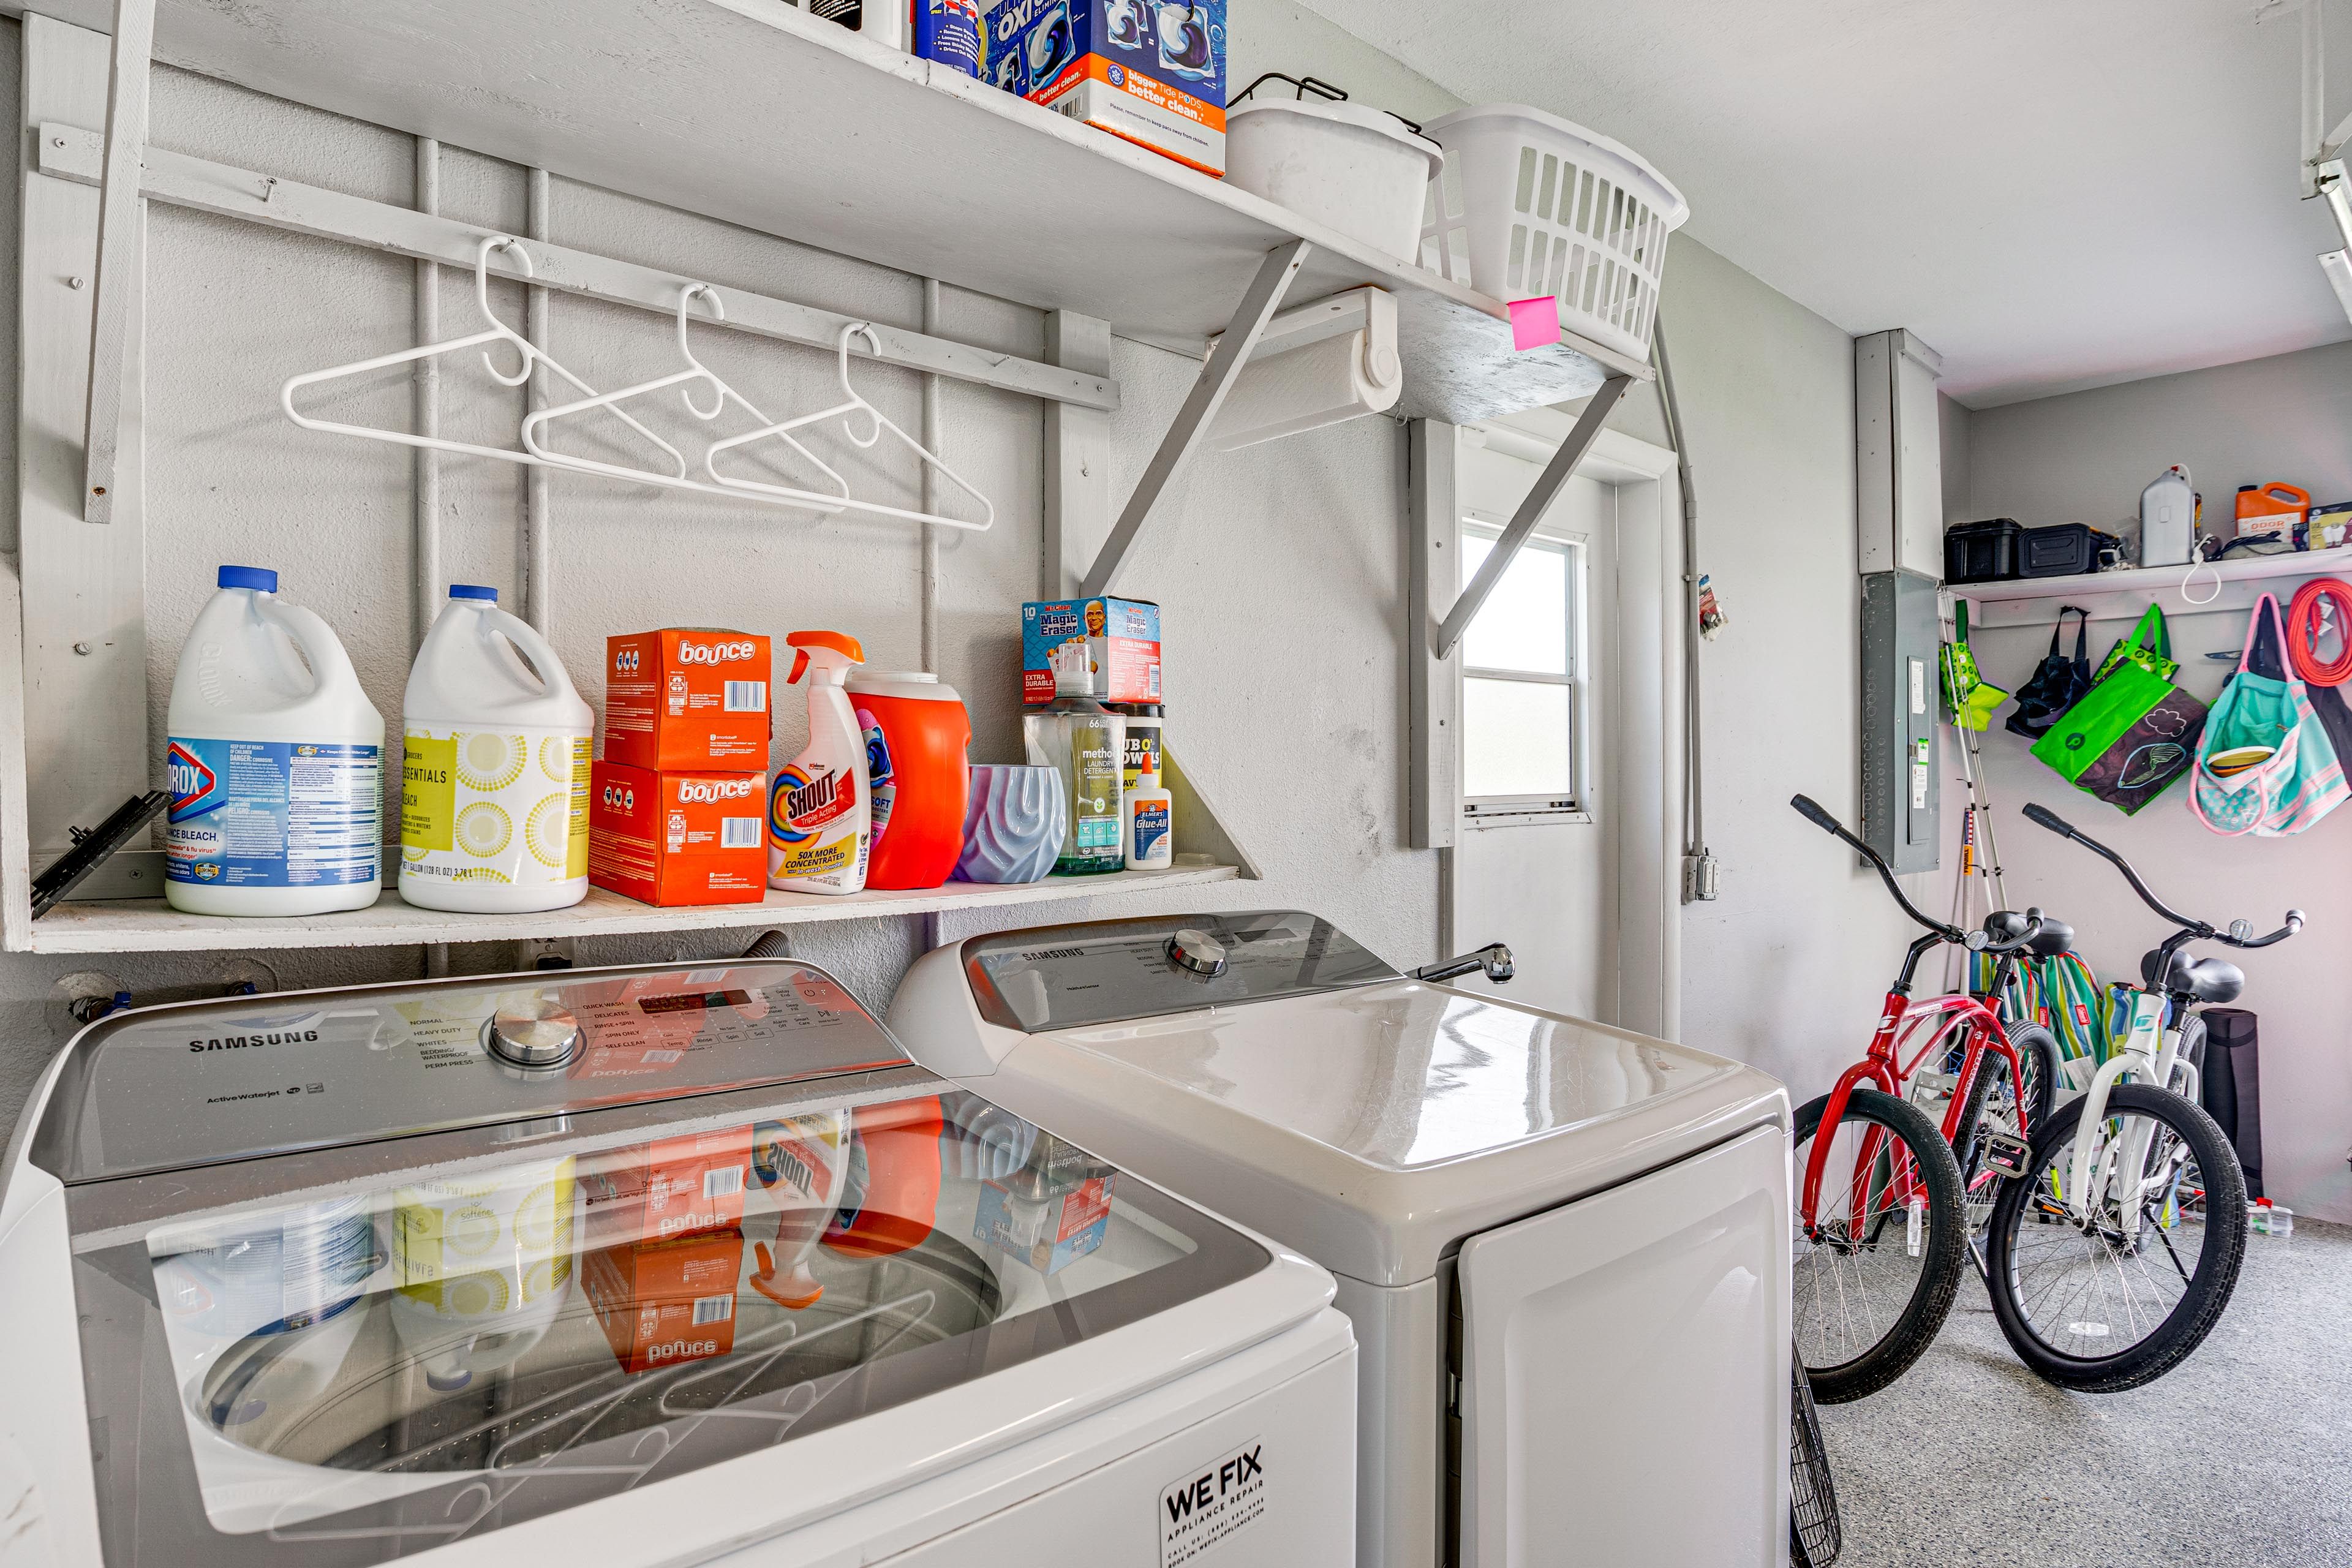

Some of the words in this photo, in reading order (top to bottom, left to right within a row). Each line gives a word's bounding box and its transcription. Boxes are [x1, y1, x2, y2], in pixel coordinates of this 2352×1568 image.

[1128, 69, 1158, 89] bigger
[1159, 83, 1176, 98] Tide
[1039, 82, 1060, 102] better
[1128, 80, 1166, 105] better
[1110, 103, 1125, 113] Please,
[1125, 109, 1146, 121] remember
[1152, 119, 1162, 127] keep
[1193, 137, 1209, 147] children.
[2251, 521, 2285, 530] ODOR
[1023, 607, 1036, 618] 10
[1040, 612, 1077, 626] Magic
[1126, 614, 1146, 626] Magic
[1040, 625, 1077, 636] Eraser
[1126, 625, 1146, 635] Eraser
[678, 641, 755, 666] bounce
[1089, 719, 1099, 728] 66
[1125, 739, 1140, 751] UB
[167, 763, 201, 795] OROX
[678, 778, 752, 804] bounce
[787, 768, 835, 820] SHOUT
[801, 813, 818, 826] Triple
[819, 804, 837, 818] Acting
[815, 820, 834, 829] PENETRATES
[1136, 819, 1167, 829] Glue-All
[797, 851, 814, 859] 50X
[815, 846, 838, 858] MORE
[785, 852, 845, 869] CONCENTRATED
[797, 866, 821, 875] In-wash
[823, 861, 844, 870] Powder
[410, 862, 423, 872] GALLON
[424, 864, 434, 874] (128
[435, 866, 441, 875] FL
[443, 867, 453, 876] OZ)
[454, 868, 467, 877] 3.78
[1022, 948, 1084, 961] SAMSUNG
[189, 1030, 318, 1053] SAMSUNG
[421, 1051, 469, 1060] WATERPROOF
[461, 1209, 494, 1221] Softener
[1166, 1472, 1214, 1523] WE
[1219, 1444, 1262, 1496] FIX
[1167, 1502, 1225, 1542] APPLIANCE
[1231, 1480, 1263, 1505] REPAIR
[1168, 1544, 1187, 1559] CALL
[1168, 1556, 1185, 1568] BOOK
[1187, 1549, 1197, 1558] ON:
